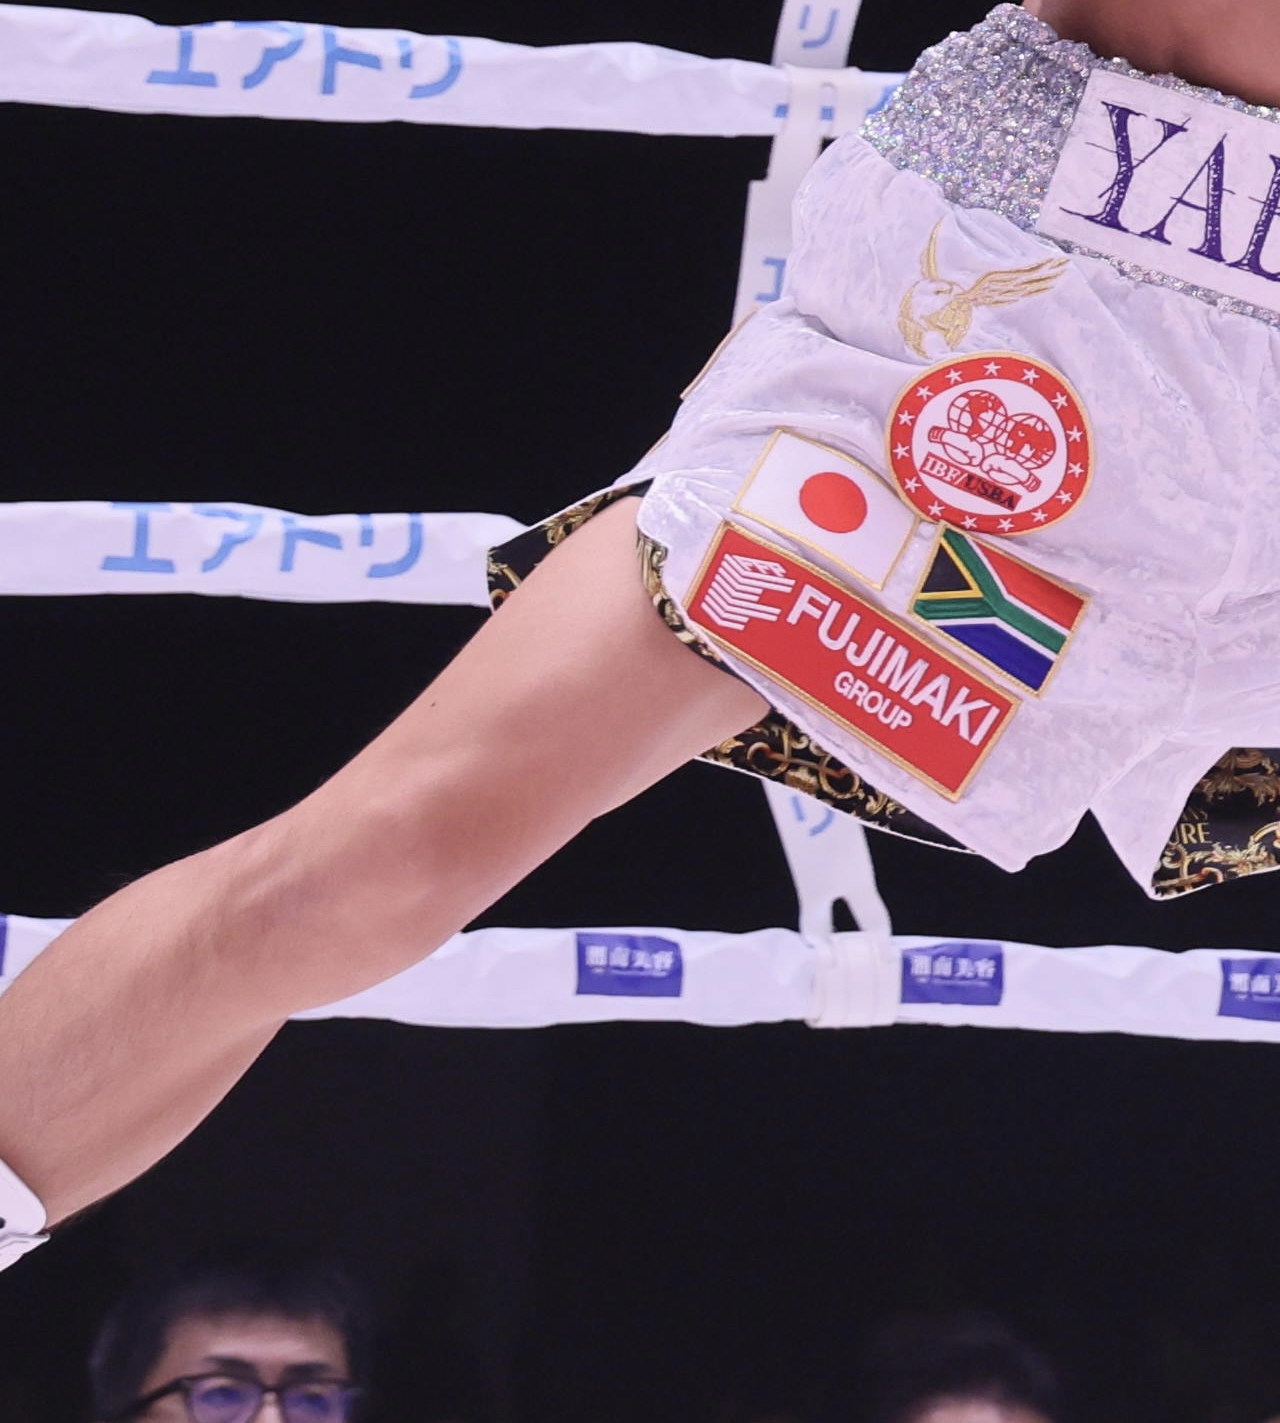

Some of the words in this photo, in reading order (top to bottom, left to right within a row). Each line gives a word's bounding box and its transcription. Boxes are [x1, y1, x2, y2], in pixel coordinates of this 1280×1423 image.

[146, 20, 462, 99] エアトリ
[101, 502, 424, 579] エアトリ
[786, 583, 1000, 746] FUJIMAKI
[833, 671, 913, 731] GROUP
